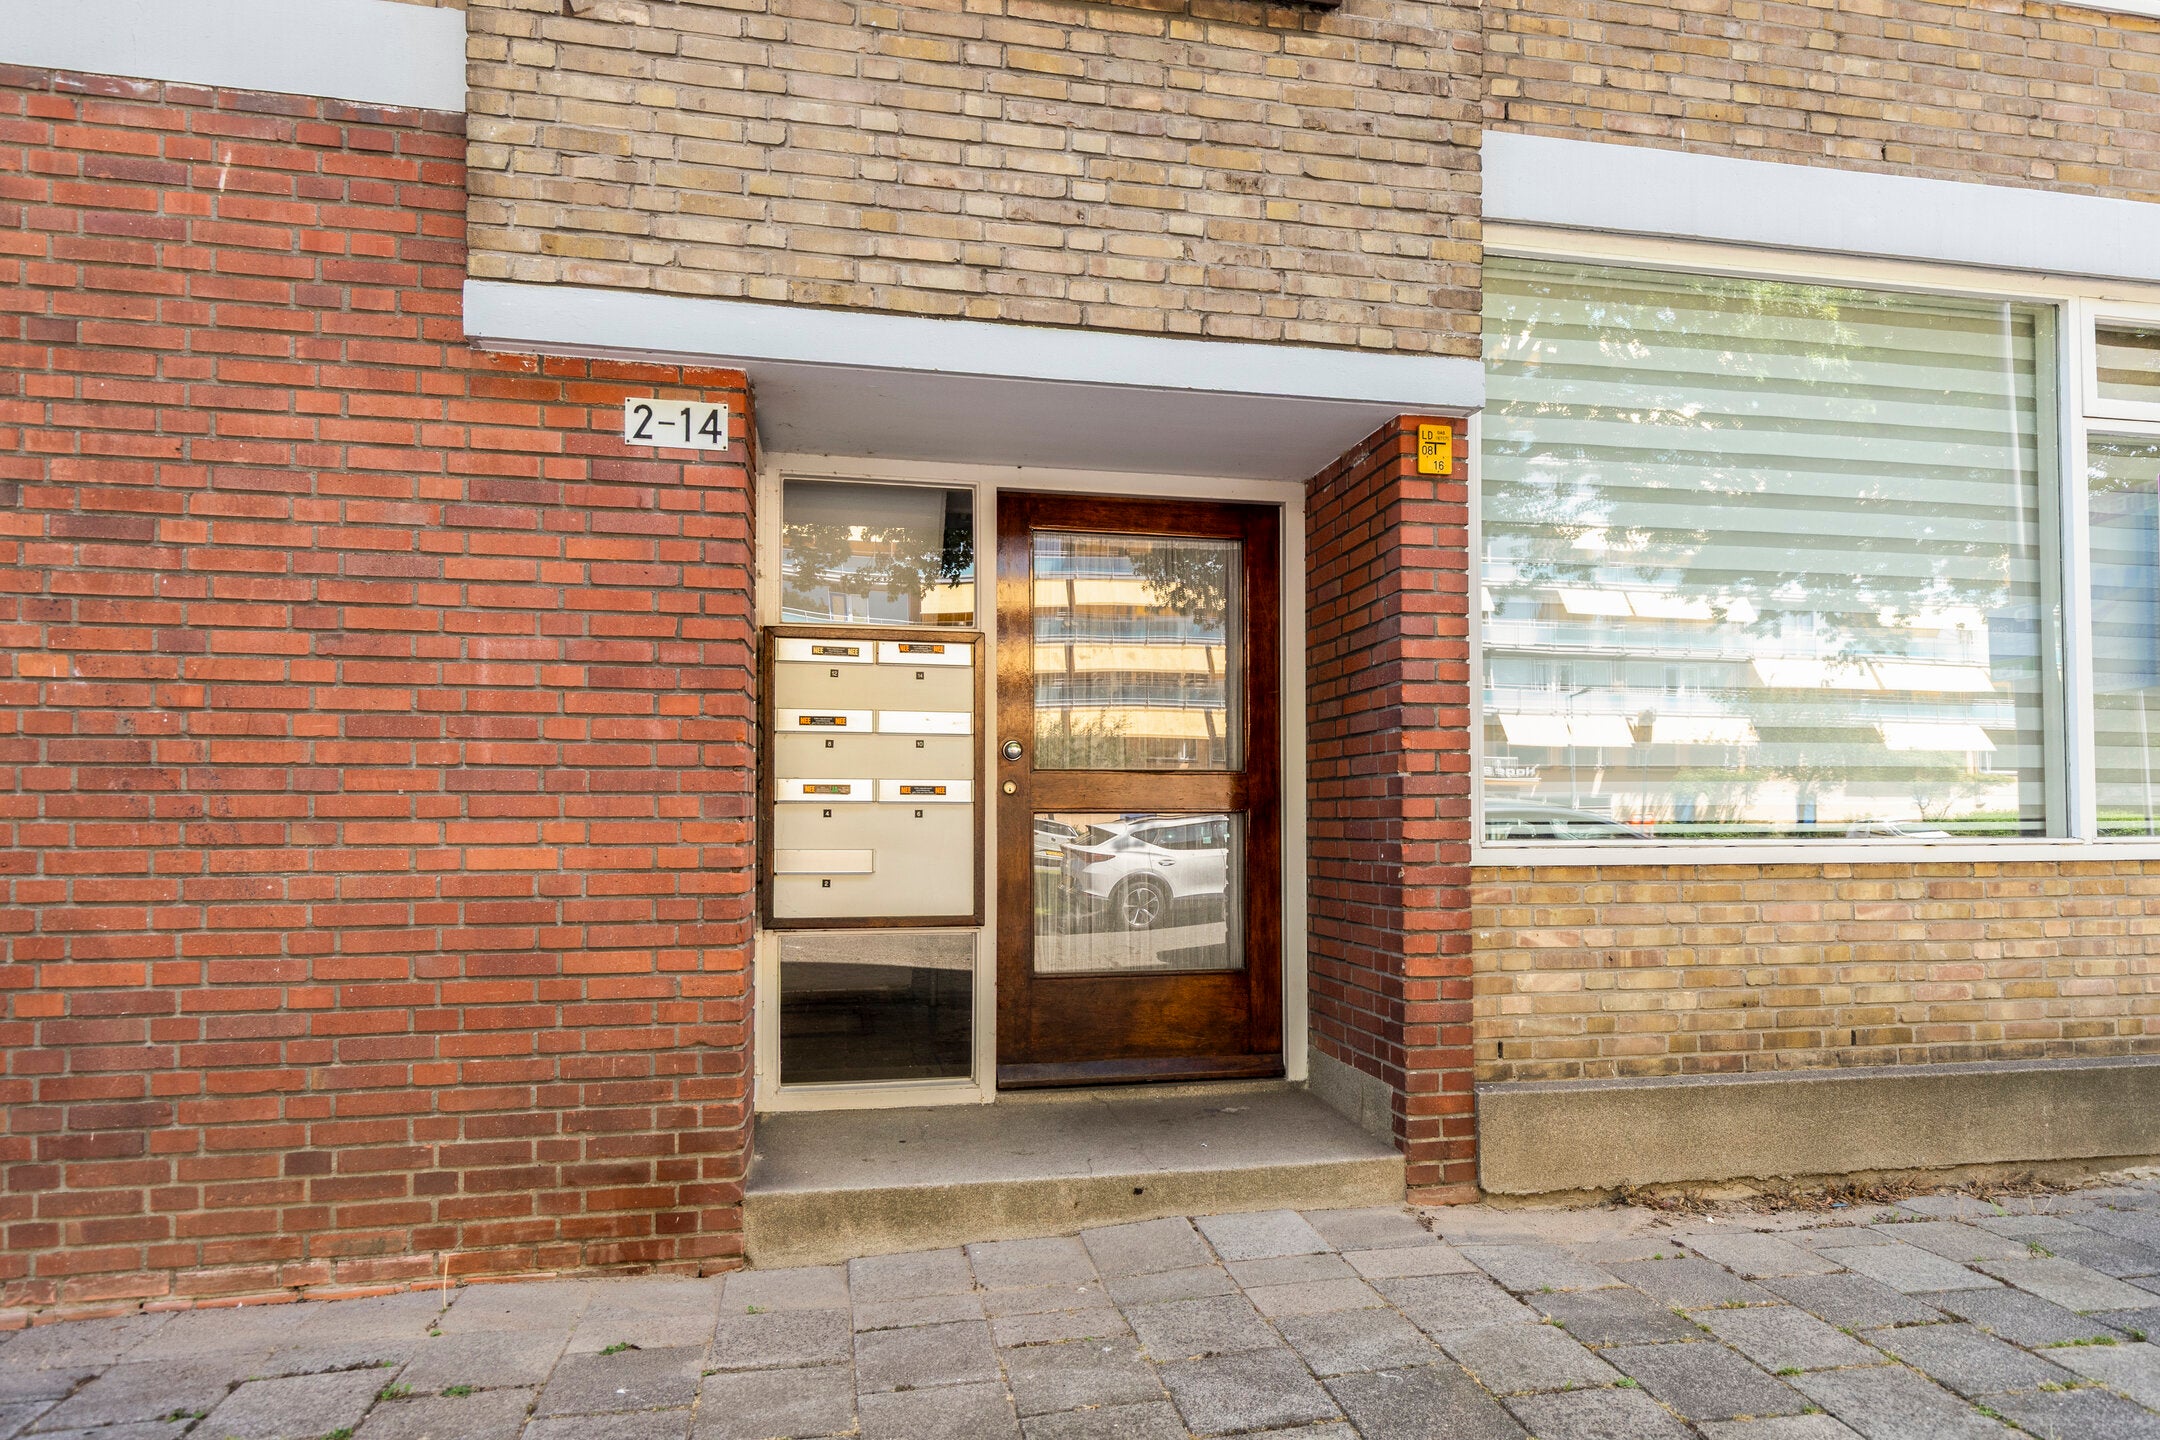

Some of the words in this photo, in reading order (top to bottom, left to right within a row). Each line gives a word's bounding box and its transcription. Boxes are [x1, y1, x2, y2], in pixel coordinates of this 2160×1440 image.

[632, 403, 722, 444] 2-14
[1434, 460, 1444, 470] 16
[813, 646, 824, 655] NEE
[847, 648, 859, 656] NEE
[899, 644, 910, 652] NEE
[933, 645, 944, 653] NEE
[800, 717, 811, 725] NEE
[835, 717, 846, 725] NEE
[804, 785, 816, 793] NEE
[901, 786, 912, 794] NEE
[935, 786, 946, 794] NEE
